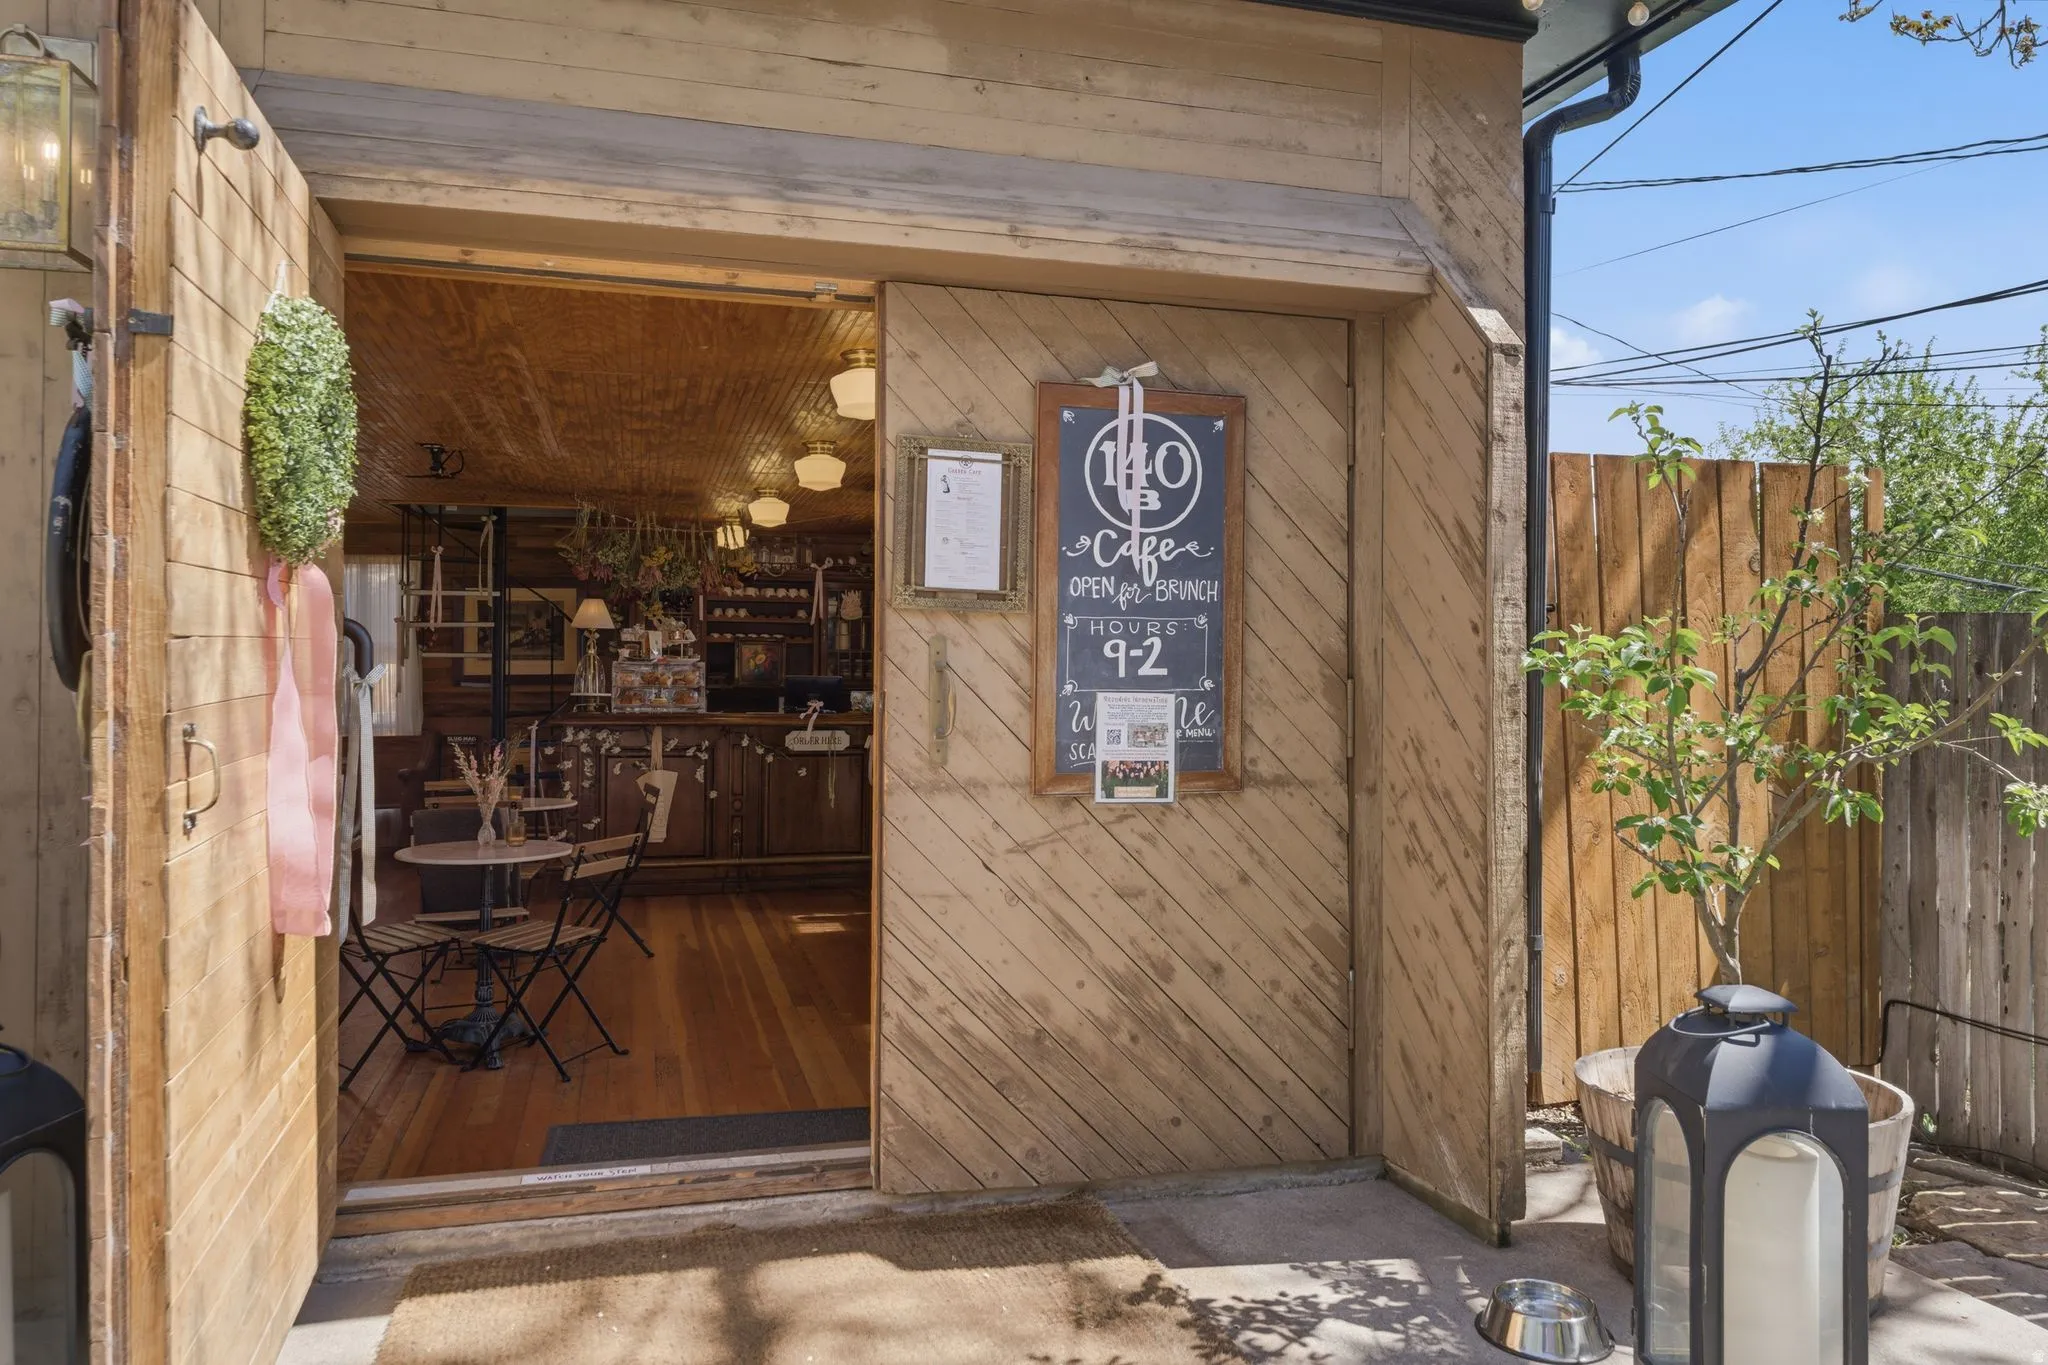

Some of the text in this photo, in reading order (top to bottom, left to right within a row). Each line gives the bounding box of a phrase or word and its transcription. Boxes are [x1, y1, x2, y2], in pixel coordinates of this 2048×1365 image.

[1093, 529, 1186, 586] Cafe
[1069, 576, 1218, 610] OPEN for BRUNCH
[1090, 620, 1188, 636] HOURS:
[1103, 636, 1168, 678] 9-2
[1069, 743, 1096, 760] SCA
[536, 1173, 573, 1181] WATCH
